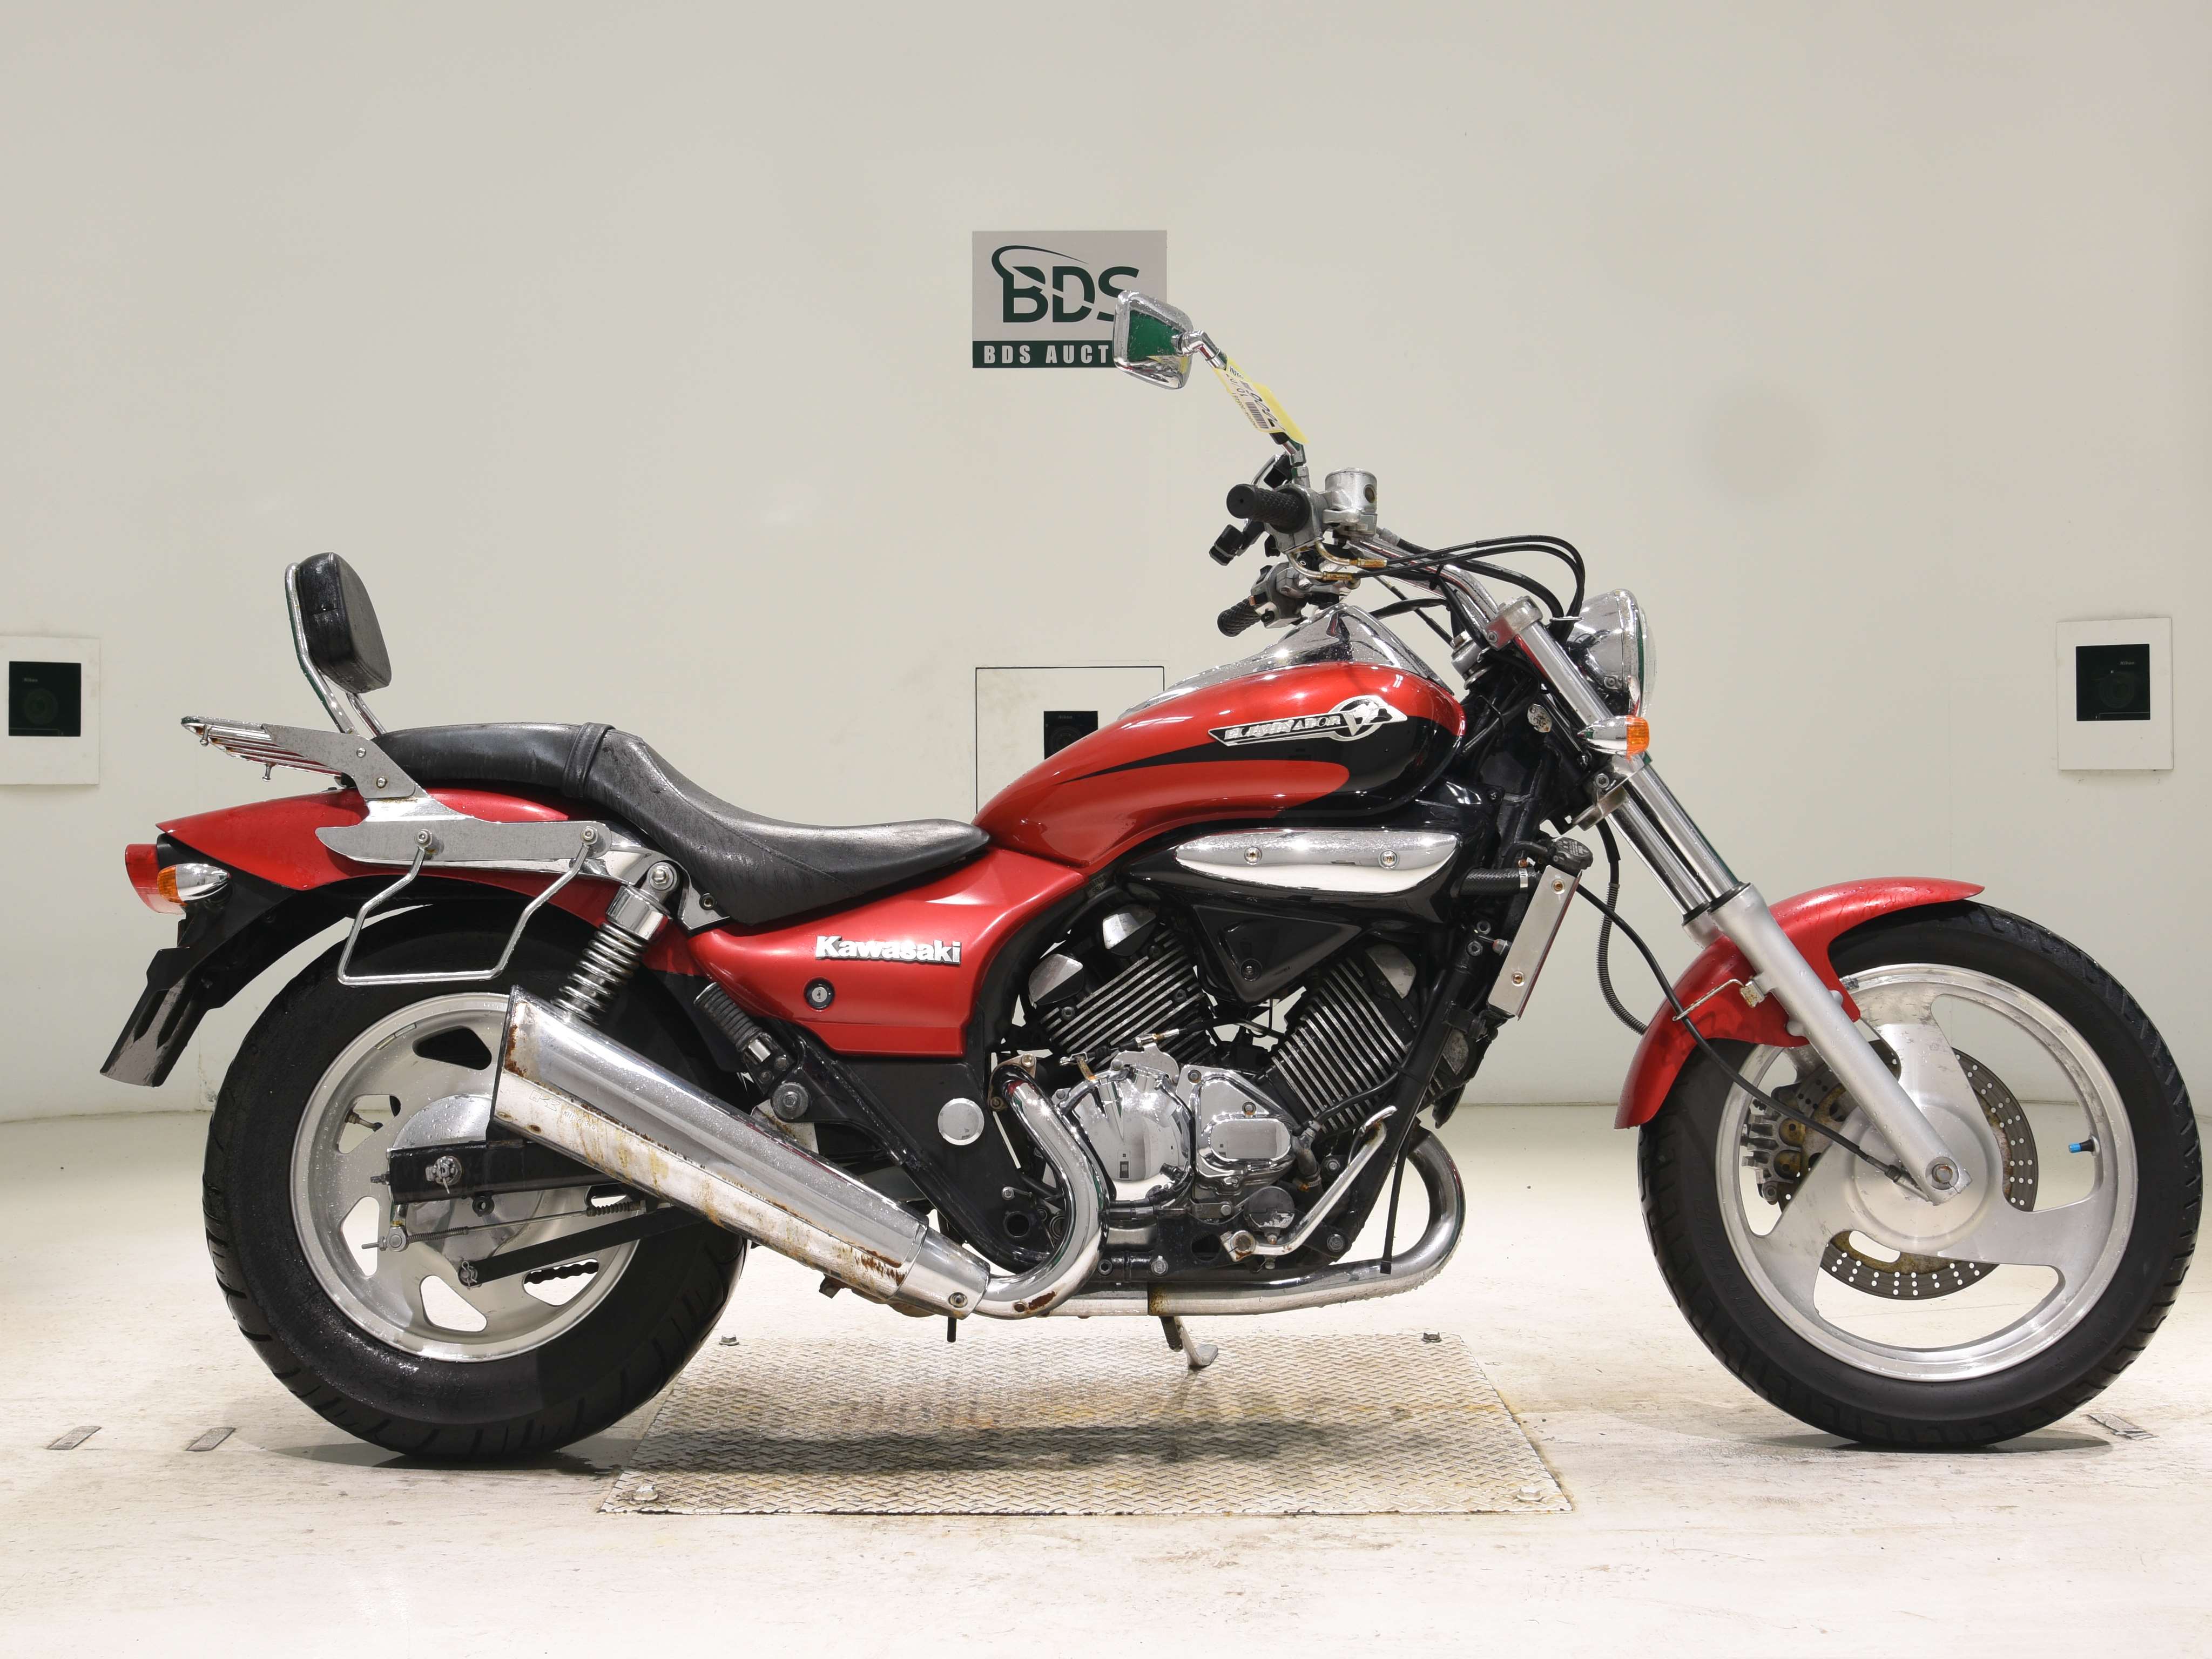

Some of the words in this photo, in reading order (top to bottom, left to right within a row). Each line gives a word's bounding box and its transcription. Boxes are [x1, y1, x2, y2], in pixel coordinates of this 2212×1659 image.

[1002, 266, 1139, 323] BDS
[984, 345, 1031, 364] BDS
[1046, 344, 1109, 364] AUCT
[815, 935, 962, 965] Kawasaki
